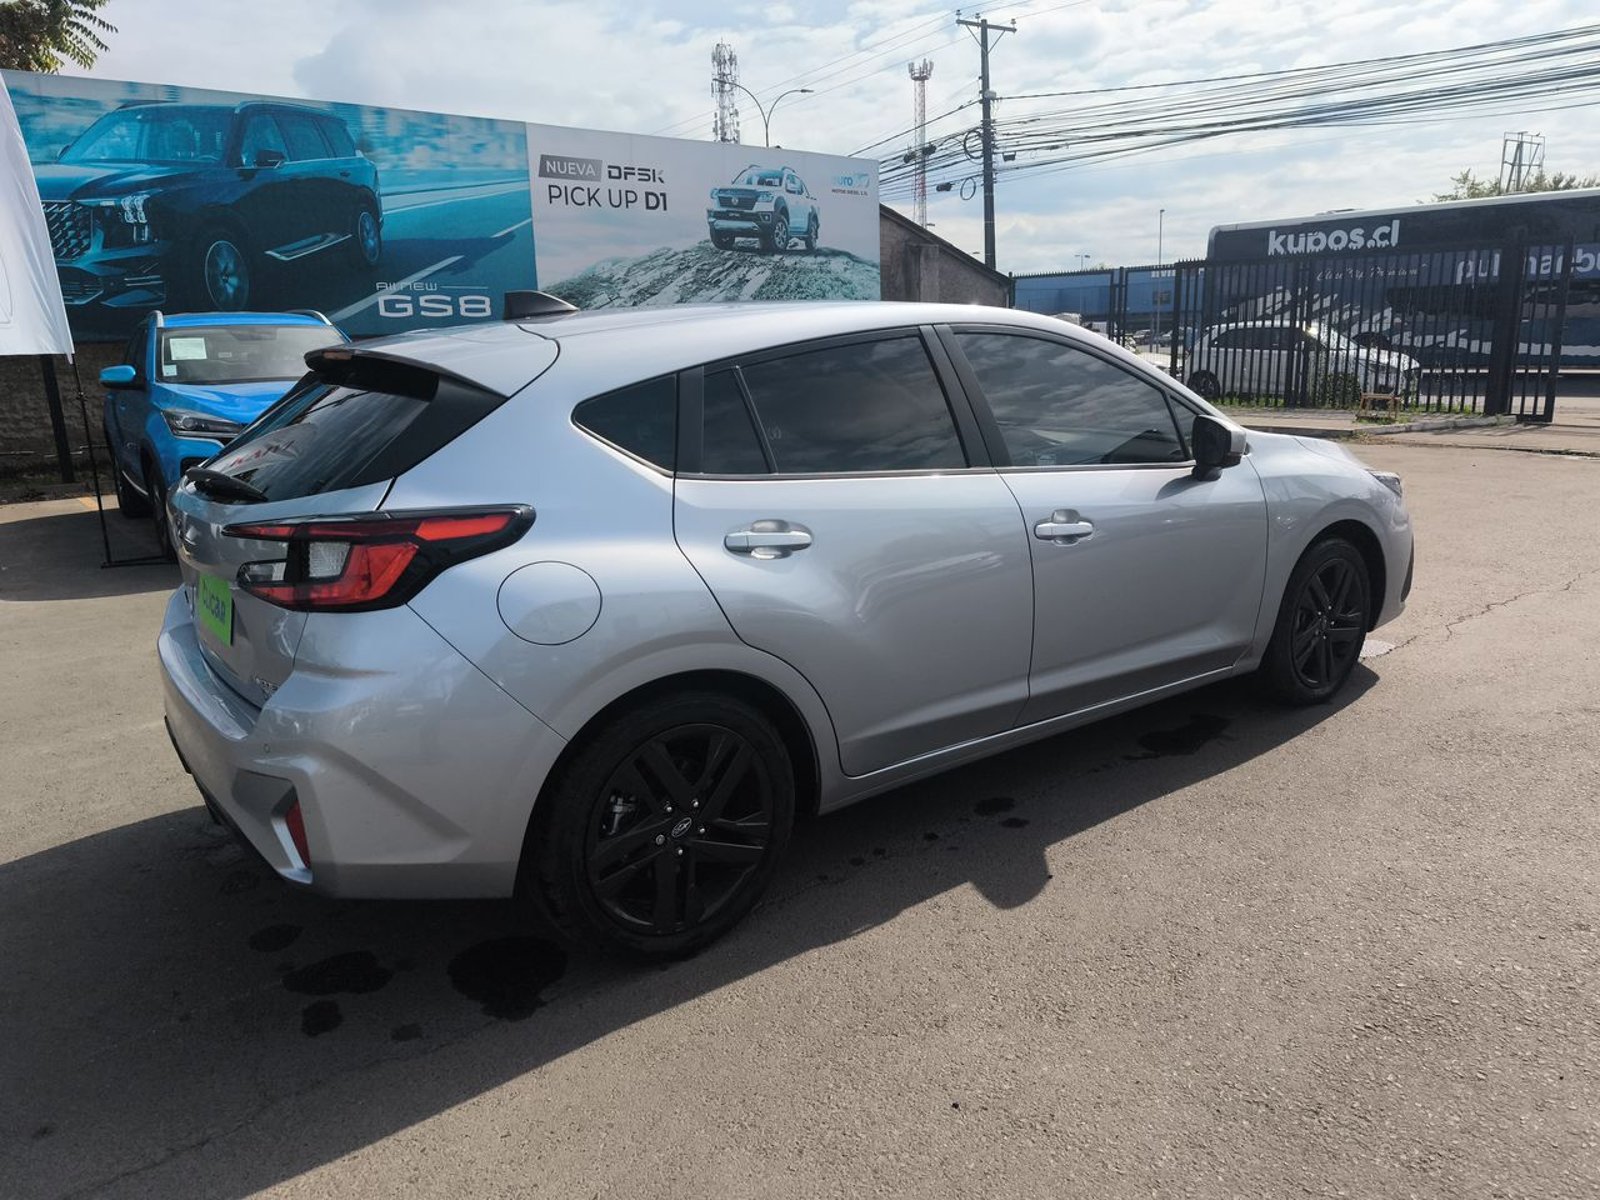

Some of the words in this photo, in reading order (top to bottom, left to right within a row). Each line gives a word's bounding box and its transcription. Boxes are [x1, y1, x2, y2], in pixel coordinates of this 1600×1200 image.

[545, 160, 596, 177] NUEVA
[607, 165, 665, 183] DFSK
[548, 184, 602, 207] PICK
[608, 188, 638, 209] UP
[645, 191, 668, 211] D1
[1267, 219, 1400, 256] kupos.cl
[378, 294, 492, 318] GS8
